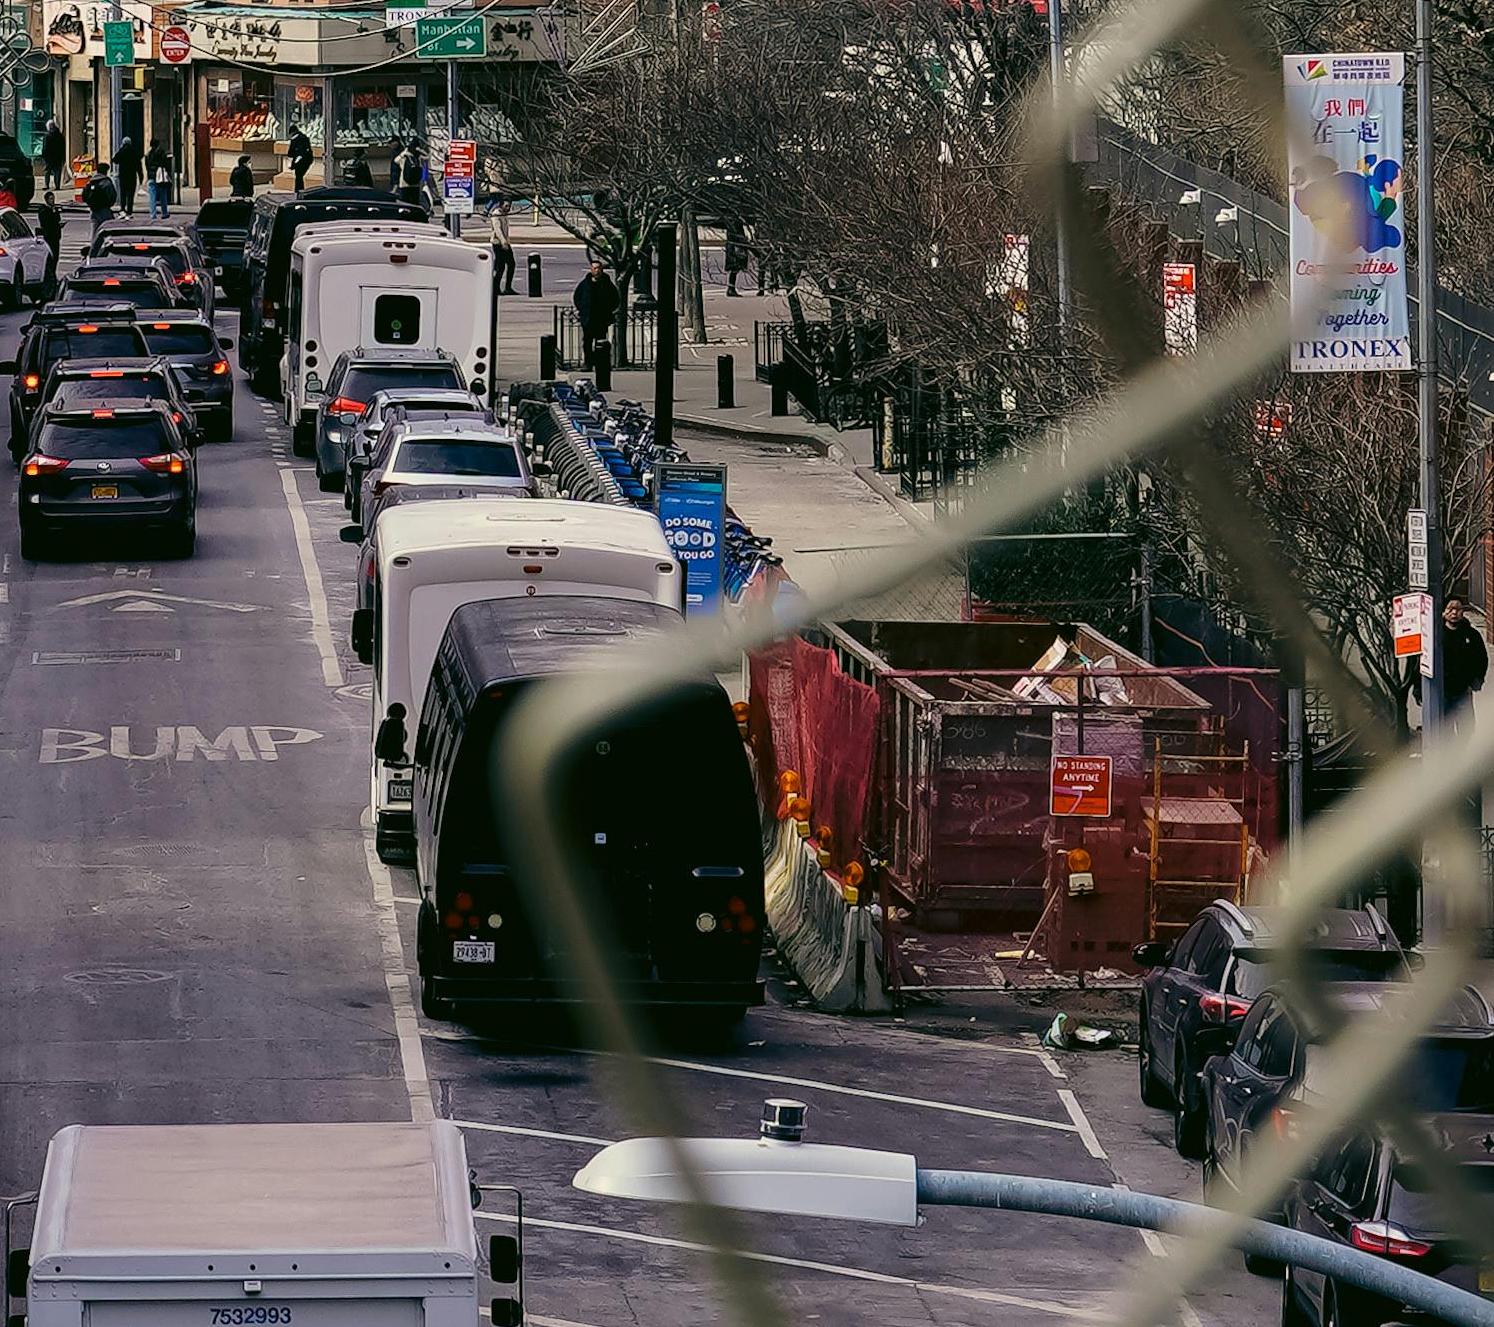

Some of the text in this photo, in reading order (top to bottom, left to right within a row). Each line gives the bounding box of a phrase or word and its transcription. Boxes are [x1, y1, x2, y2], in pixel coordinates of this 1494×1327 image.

[421, 24, 481, 36] Manhattan
[1332, 58, 1374, 68] CHINATOWN
[1324, 98, 1366, 117] 我們
[1313, 121, 1381, 144] 在一起
[1296, 338, 1405, 359] TRONEX
[665, 517, 713, 529] DO SOME
[679, 550, 715, 559] YOU GO
[38, 726, 325, 764] BUMP
[1057, 761, 1106, 771] NO STANDING
[1062, 773, 1100, 783] ANYTIME
[210, 1307, 292, 1325] 7532993
